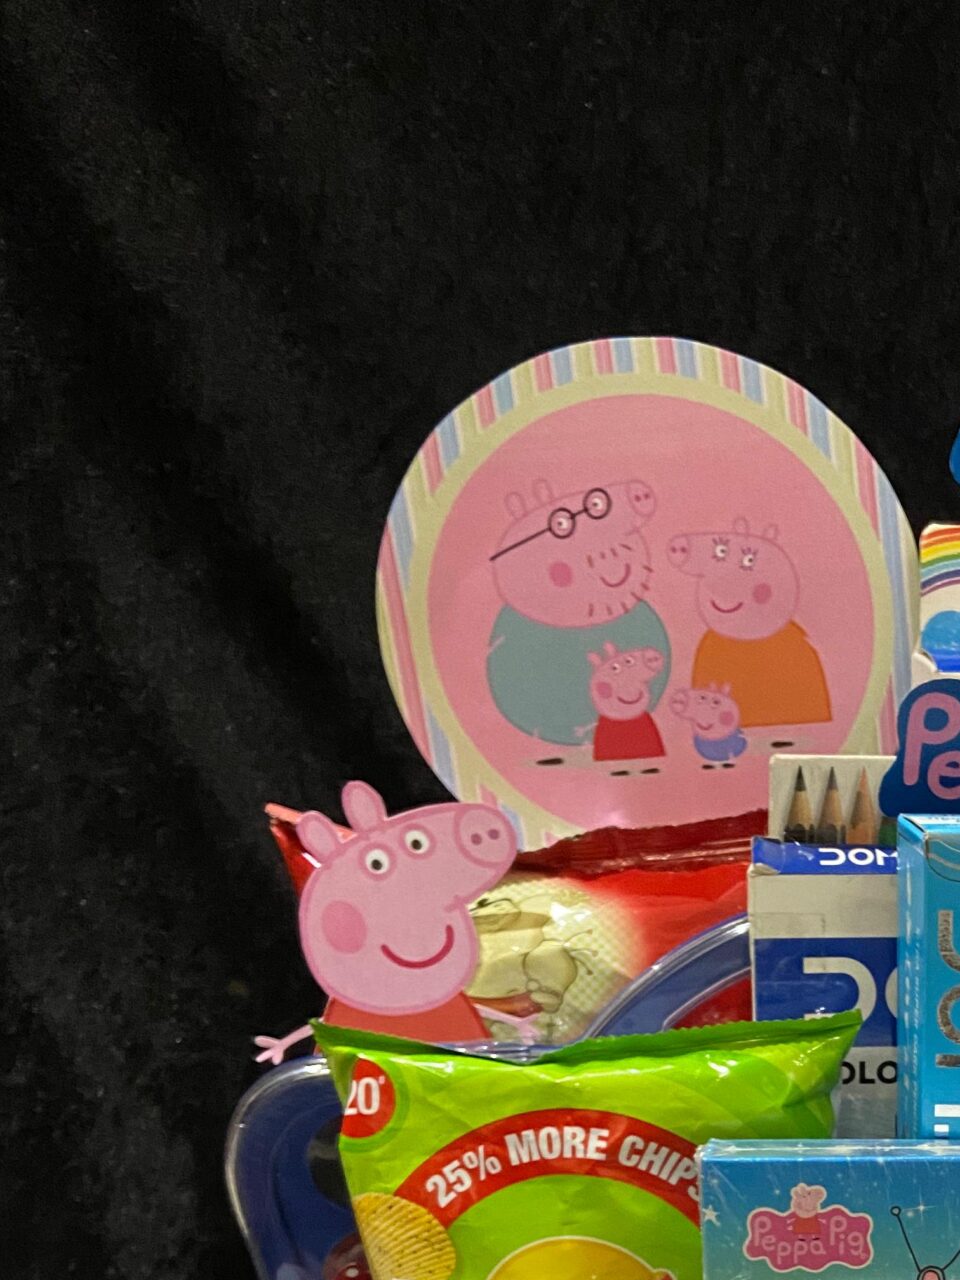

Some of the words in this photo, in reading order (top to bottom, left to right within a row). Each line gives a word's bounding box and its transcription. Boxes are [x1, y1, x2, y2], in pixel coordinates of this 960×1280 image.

[819, 848, 899, 866] DOM
[425, 1147, 502, 1210] 25%
[503, 1125, 610, 1167] MORE
[753, 1214, 828, 1265] Peppa
[829, 1213, 868, 1260] Pig
